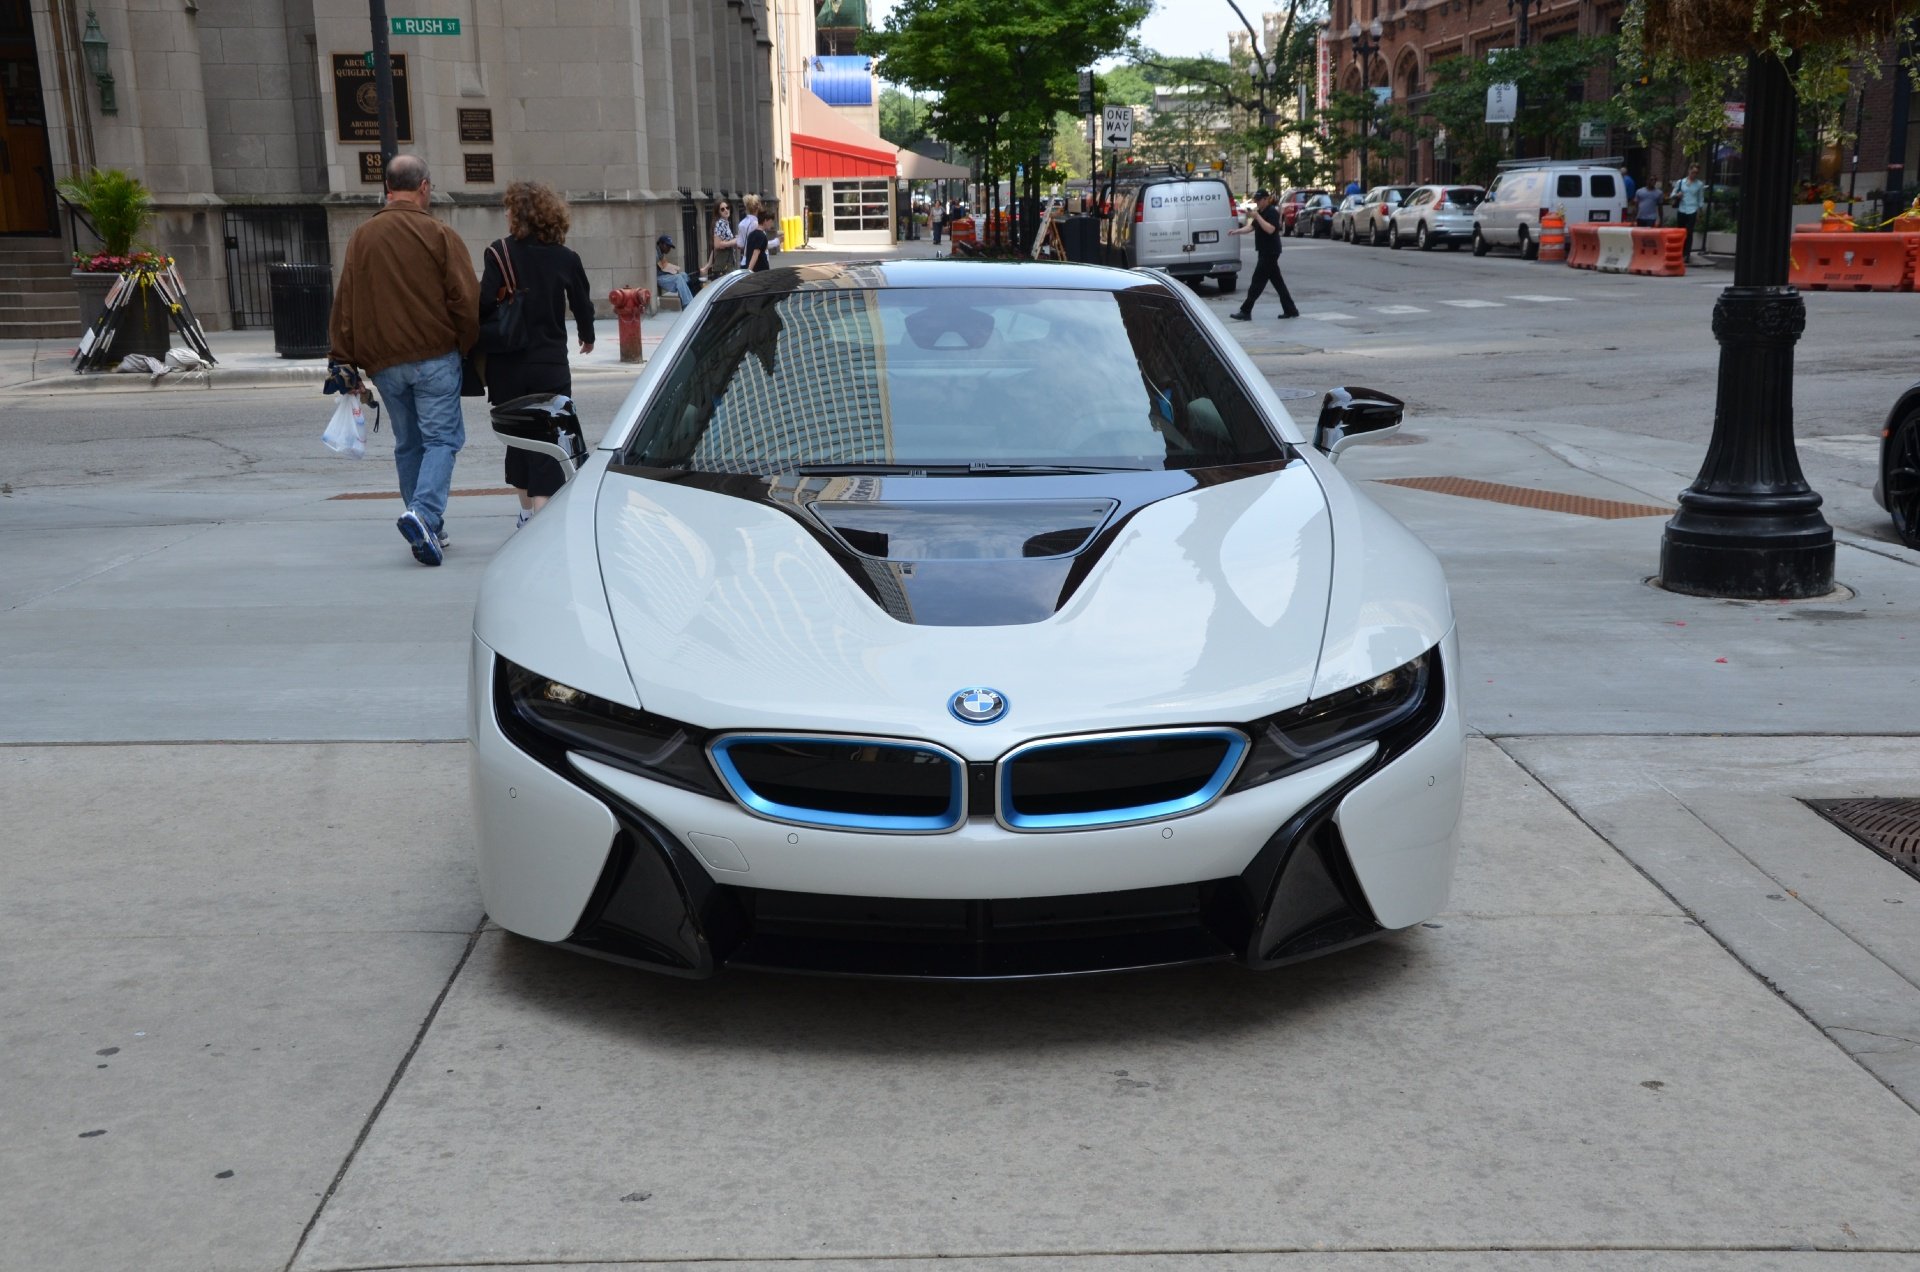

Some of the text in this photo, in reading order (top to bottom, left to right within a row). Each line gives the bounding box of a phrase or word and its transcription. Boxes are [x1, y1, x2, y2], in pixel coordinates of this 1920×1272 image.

[396, 19, 456, 33] N RUSH ST
[336, 68, 373, 77] QUIGLEY
[1107, 109, 1130, 121] ONE
[1106, 121, 1130, 132] WAY
[366, 153, 382, 167] 83
[1164, 193, 1222, 204] AIR COMFORT
